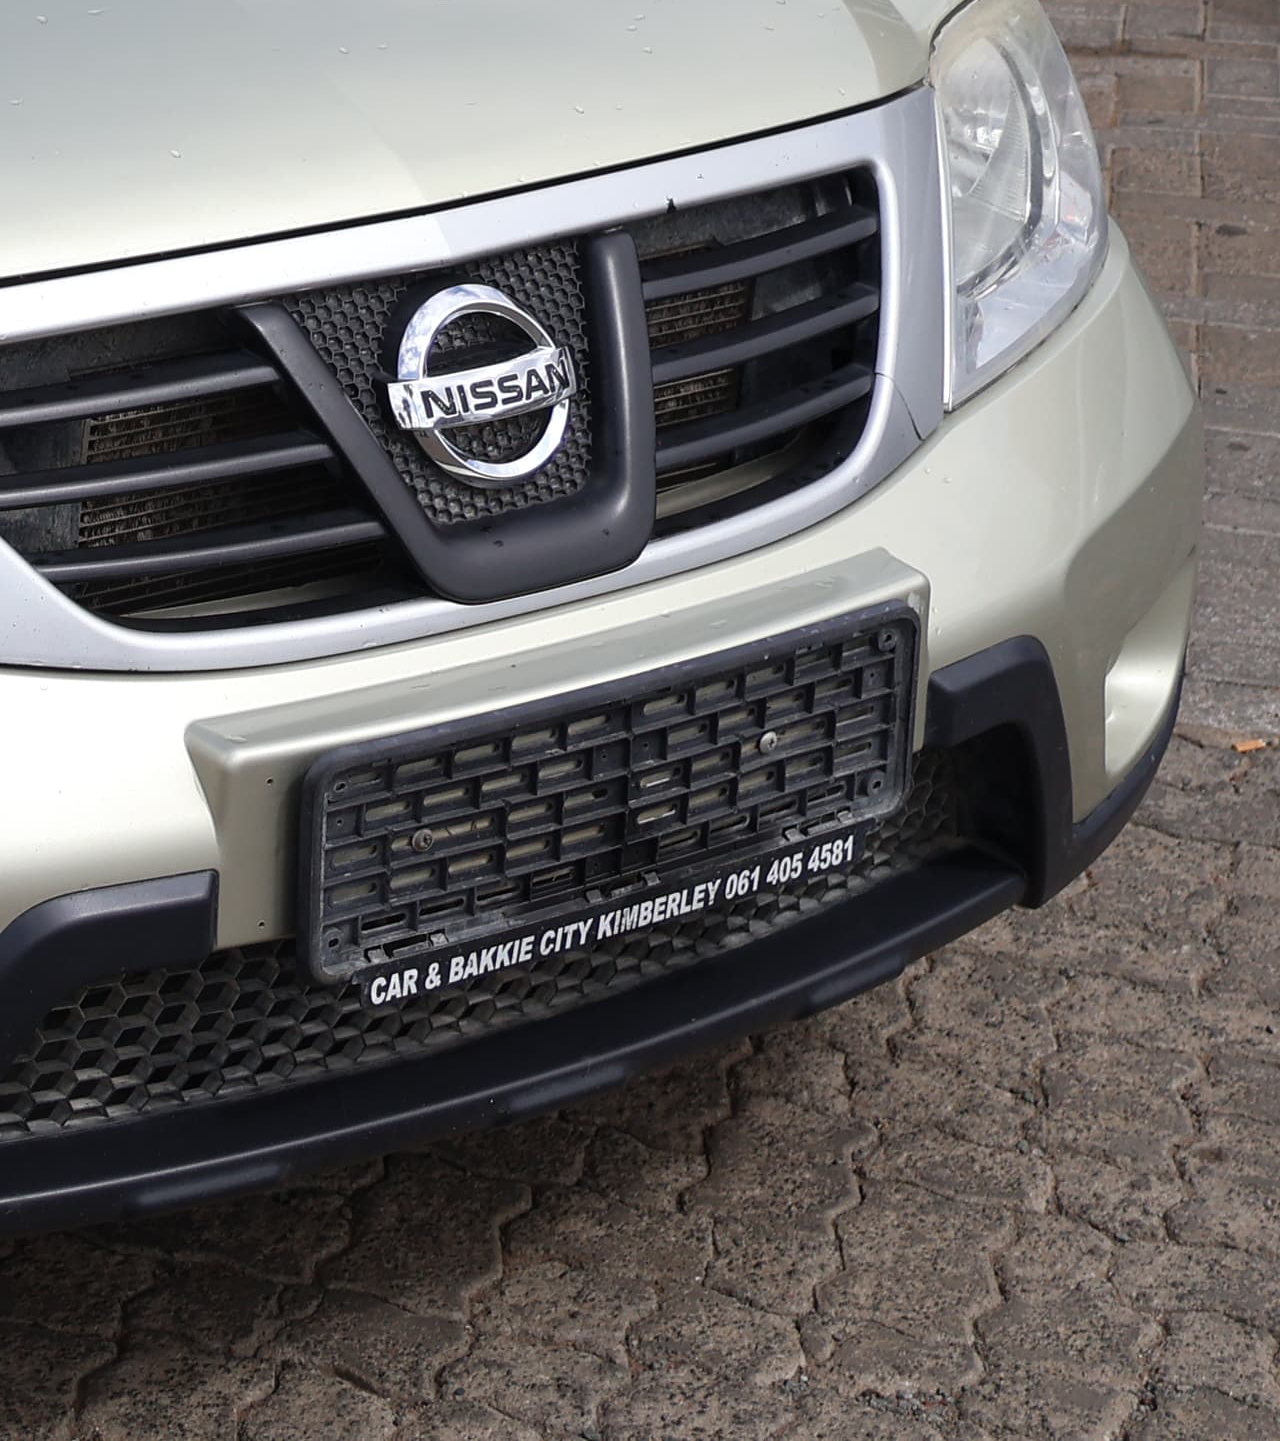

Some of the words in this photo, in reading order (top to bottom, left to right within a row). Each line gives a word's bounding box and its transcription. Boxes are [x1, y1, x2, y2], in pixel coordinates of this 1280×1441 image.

[420, 359, 570, 420] NISSAN
[370, 968, 418, 1006] CAR
[424, 961, 442, 991] &
[447, 936, 535, 986] BAKKIE
[539, 917, 595, 958] CITY
[596, 877, 723, 939] KIMBERLEY
[724, 870, 761, 901] 061
[765, 856, 804, 886] 405
[807, 835, 856, 874] 4581
